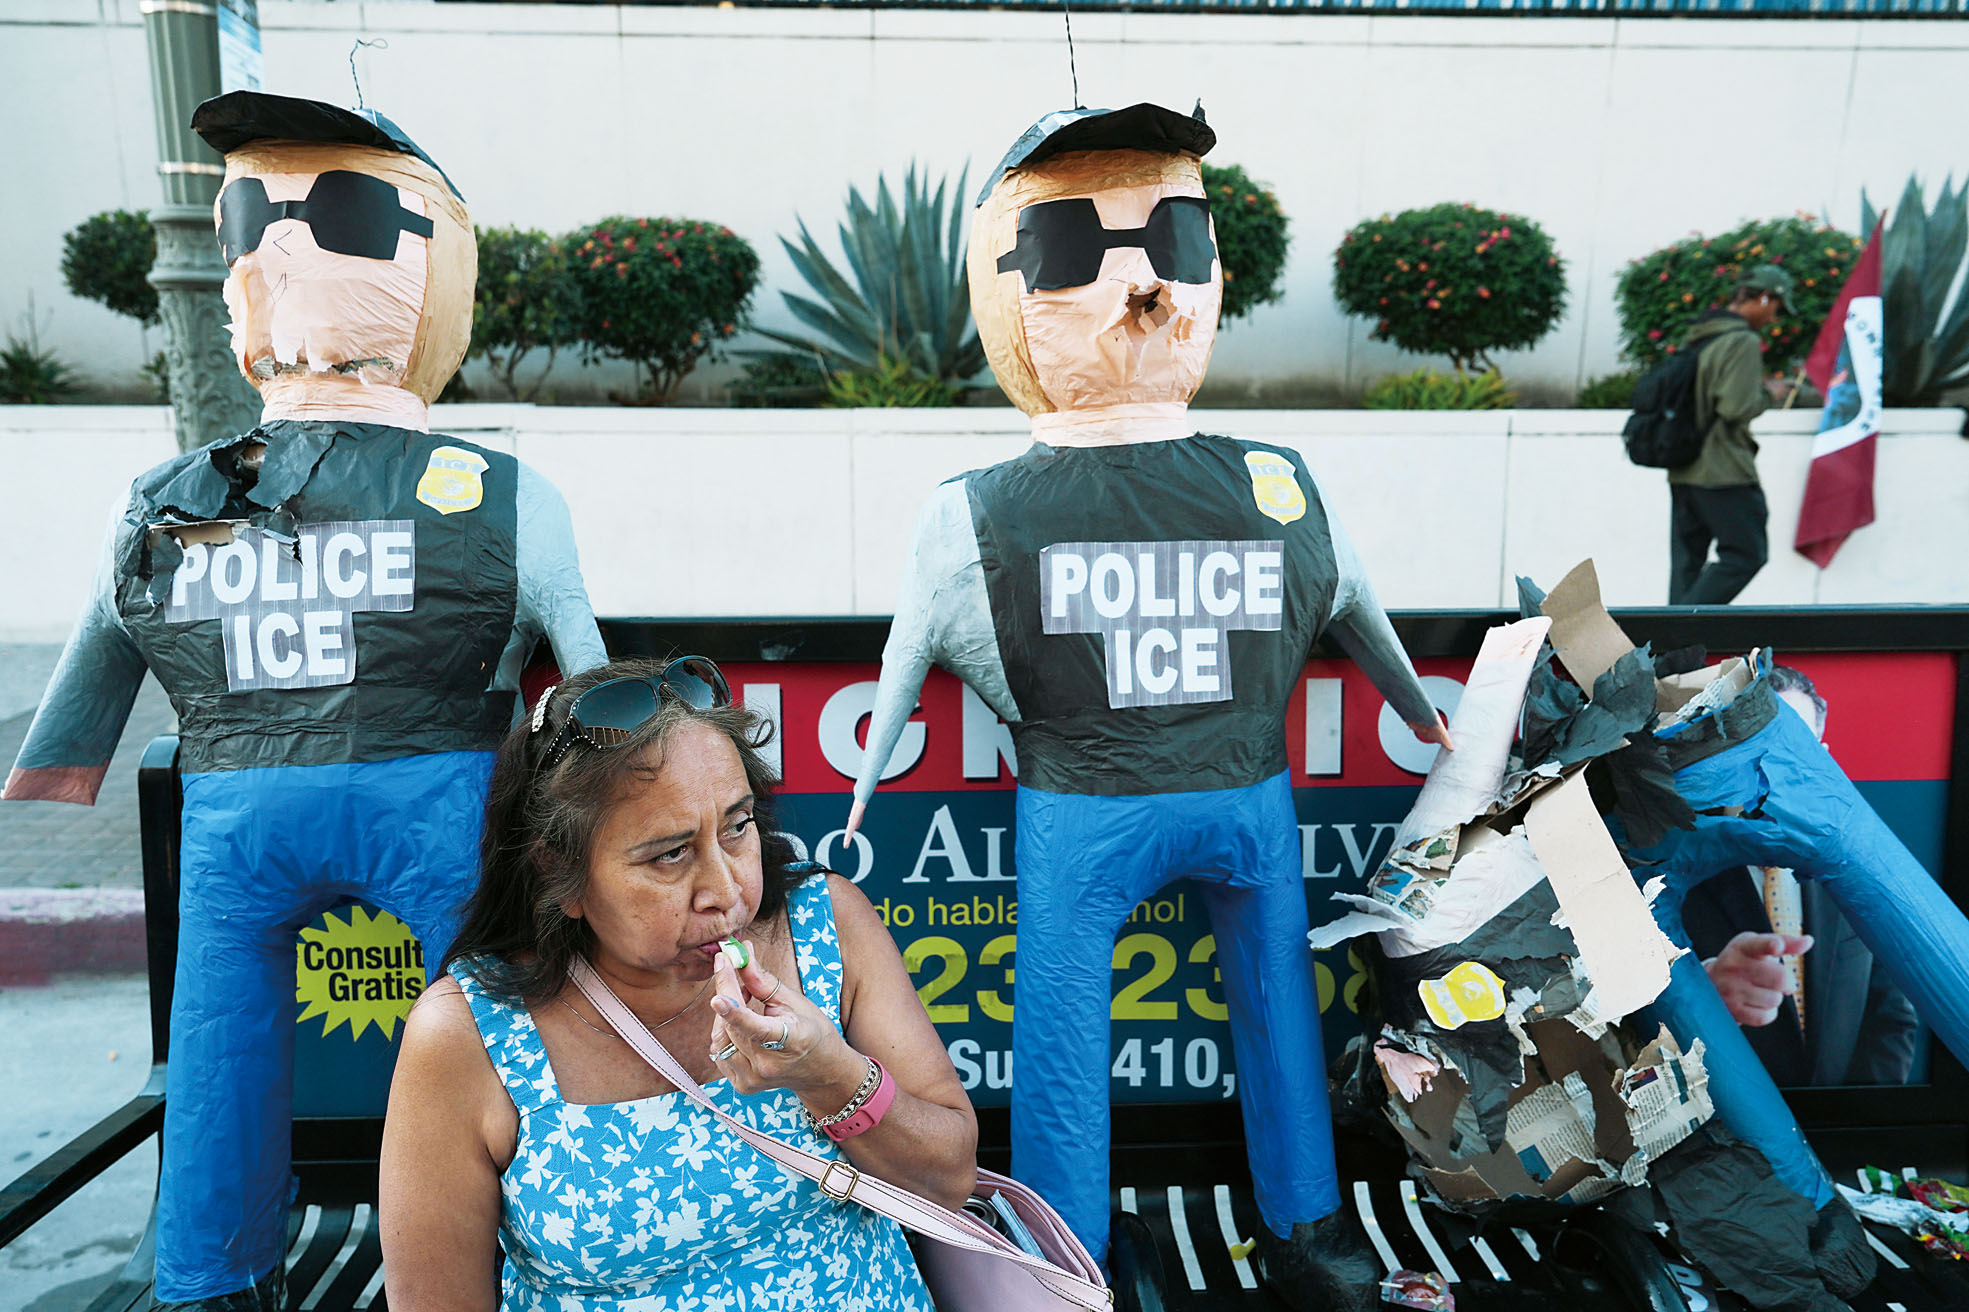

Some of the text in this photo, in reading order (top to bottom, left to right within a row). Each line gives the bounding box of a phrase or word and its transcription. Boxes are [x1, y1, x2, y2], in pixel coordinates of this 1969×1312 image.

[172, 531, 414, 606] POLICE
[1051, 551, 1282, 618] POLICE
[233, 610, 346, 680] ICE
[1115, 628, 1220, 694] ICE
[902, 804, 1018, 883] AL
[1297, 823, 1402, 879] LV
[873, 897, 915, 927] do
[928, 895, 1018, 926] habla
[304, 939, 425, 971] Consult
[328, 971, 422, 1002] Gratis
[947, 1037, 1236, 1098] Su 410,
